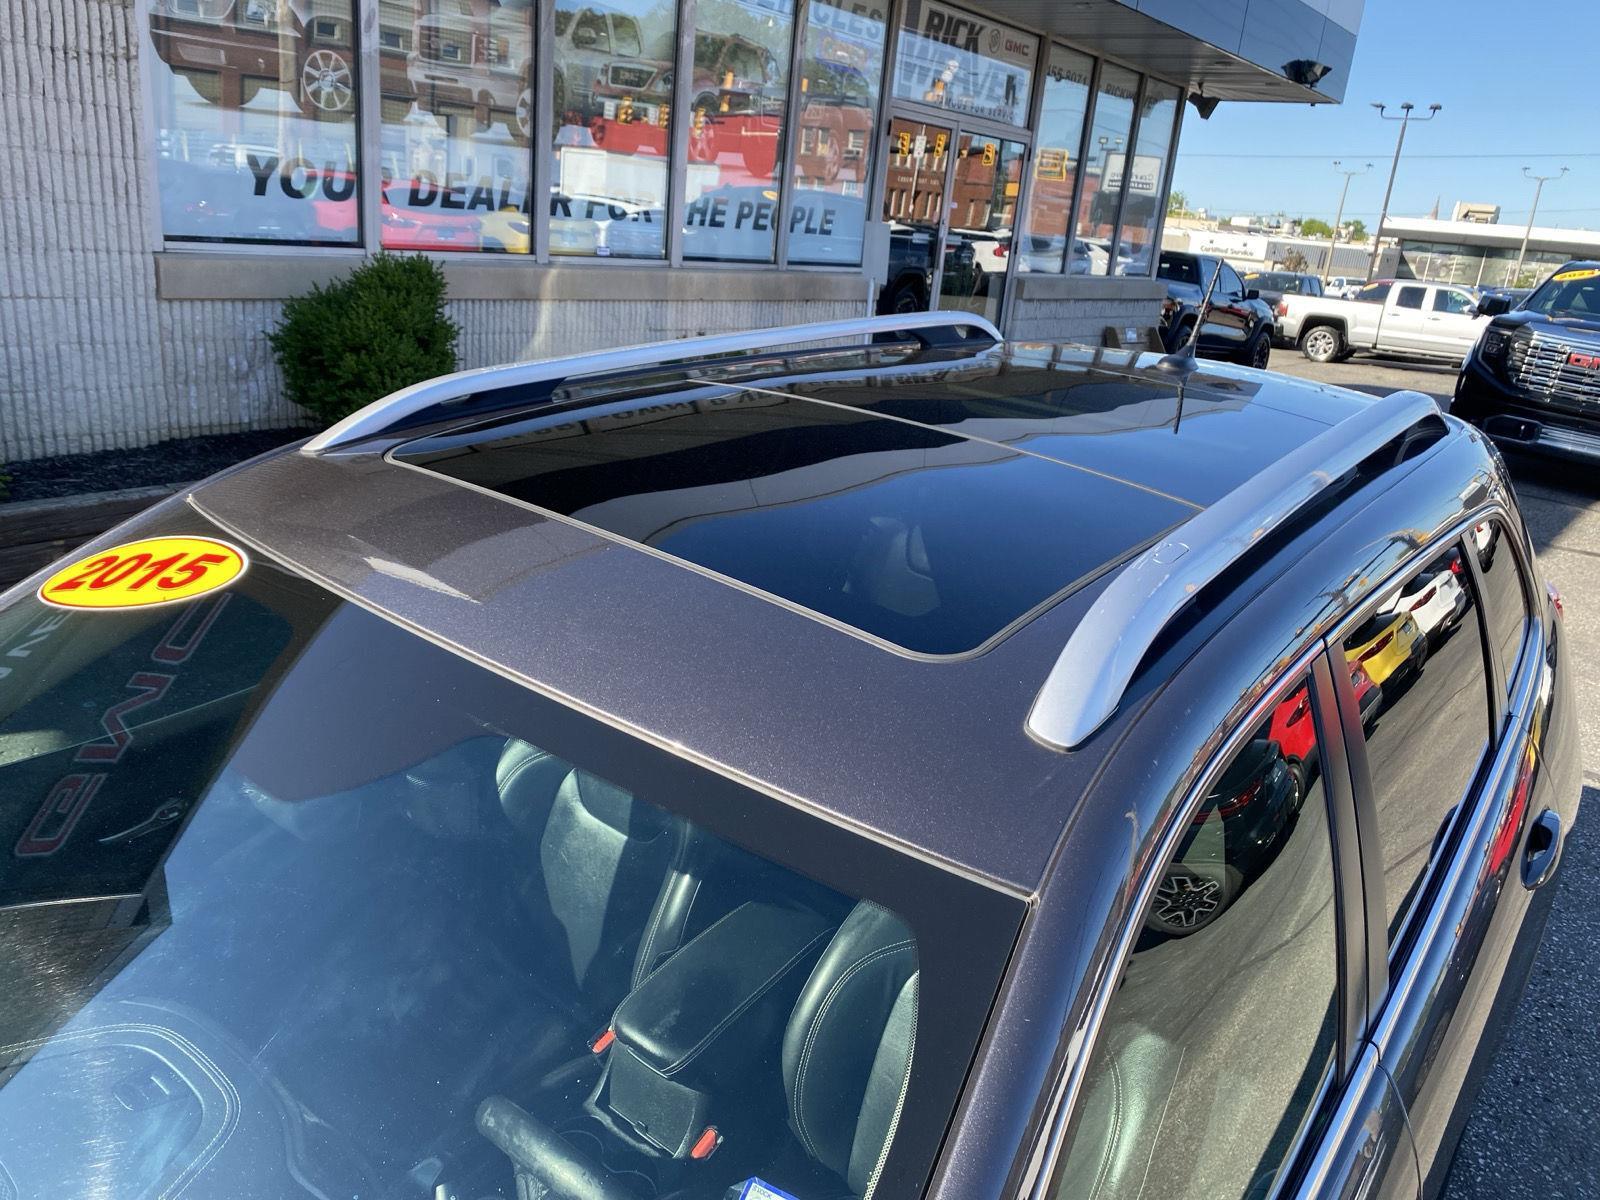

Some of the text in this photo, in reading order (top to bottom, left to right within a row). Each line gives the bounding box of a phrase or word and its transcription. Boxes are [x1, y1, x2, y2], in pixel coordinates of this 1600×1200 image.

[923, 8, 988, 54] RICK
[1004, 39, 1030, 57] GMC
[686, 197, 728, 228] HE
[1230, 248, 1254, 257] Service
[49, 552, 232, 592] 2015
